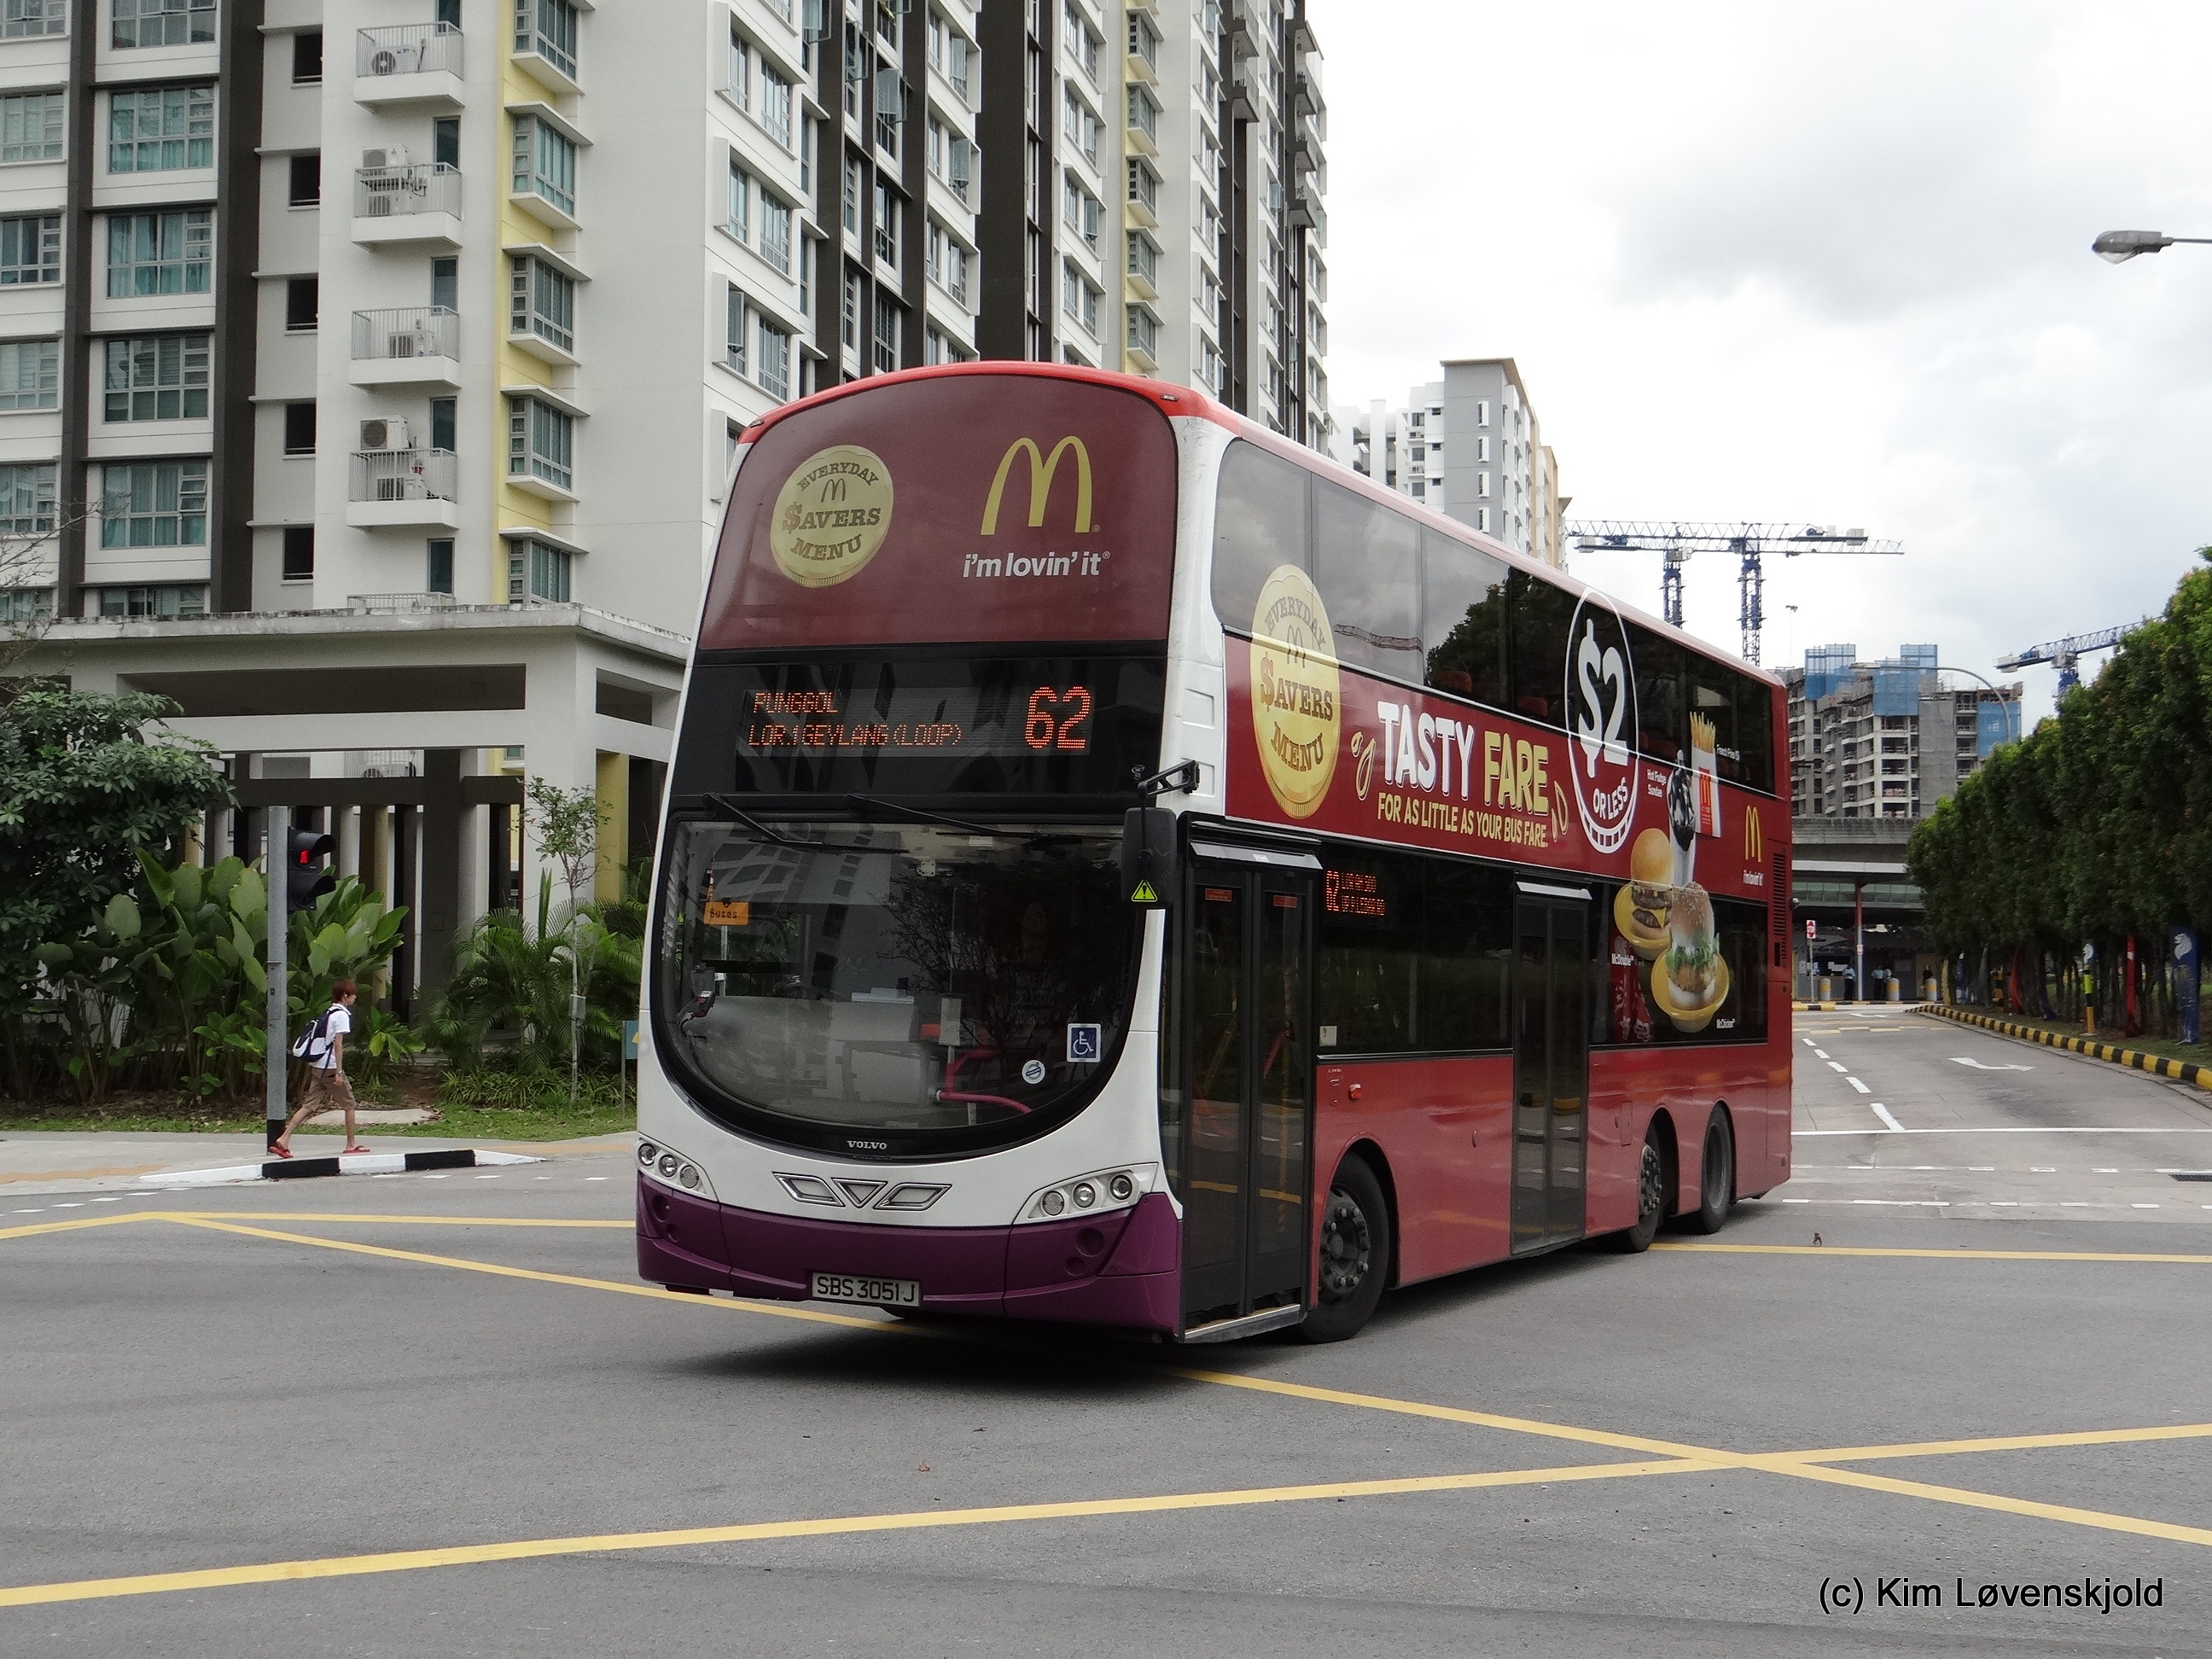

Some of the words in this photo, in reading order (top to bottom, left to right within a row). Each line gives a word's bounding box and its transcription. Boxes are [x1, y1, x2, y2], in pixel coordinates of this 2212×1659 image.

[797, 462, 879, 492] EVERYDAY
[790, 534, 862, 562] MENU
[963, 553, 1002, 578] i'm
[1005, 552, 1077, 577] lovin'
[1264, 596, 1326, 653] EVERYDAY
[753, 692, 838, 713] PUNGGOL
[1025, 686, 1092, 750] 62
[1578, 619, 1628, 778] $2
[1271, 721, 1324, 773] MENU
[1377, 701, 1475, 801] TASTY
[1484, 731, 1549, 816] FARE
[1377, 792, 1401, 823] FOR
[1404, 796, 1419, 825] AS
[1421, 800, 1458, 832] LITTLE
[1460, 807, 1474, 835] AS
[1476, 811, 1502, 840] YOUR
[1504, 817, 1522, 844] BUS
[1523, 821, 1548, 848] FARE.
[1592, 787, 1606, 819] OR
[1606, 777, 1628, 819] LESS
[847, 1140, 888, 1150] VOLVO
